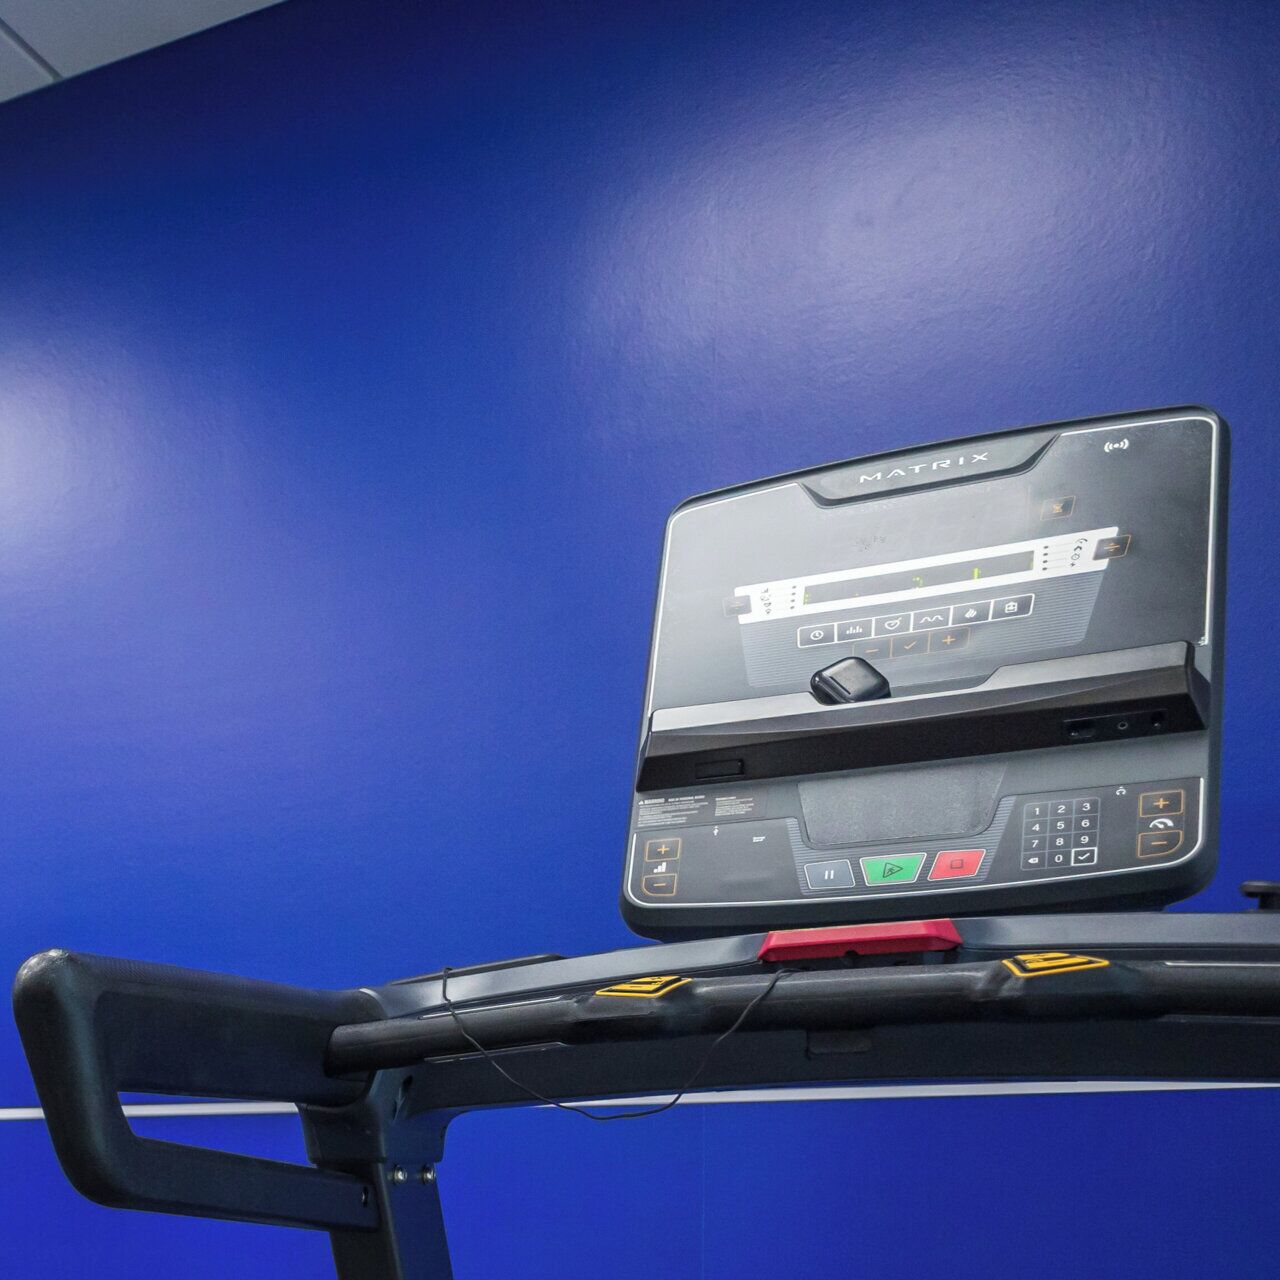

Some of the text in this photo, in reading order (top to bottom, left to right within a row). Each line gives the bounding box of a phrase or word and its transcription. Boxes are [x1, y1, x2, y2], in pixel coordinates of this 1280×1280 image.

[859, 452, 989, 483] MATRIX
[1057, 805, 1066, 813] 2
[1082, 802, 1091, 811] 3
[1032, 819, 1090, 831] 4 5 6
[1031, 835, 1089, 848] 7 8 9
[1054, 854, 1063, 863] 0
